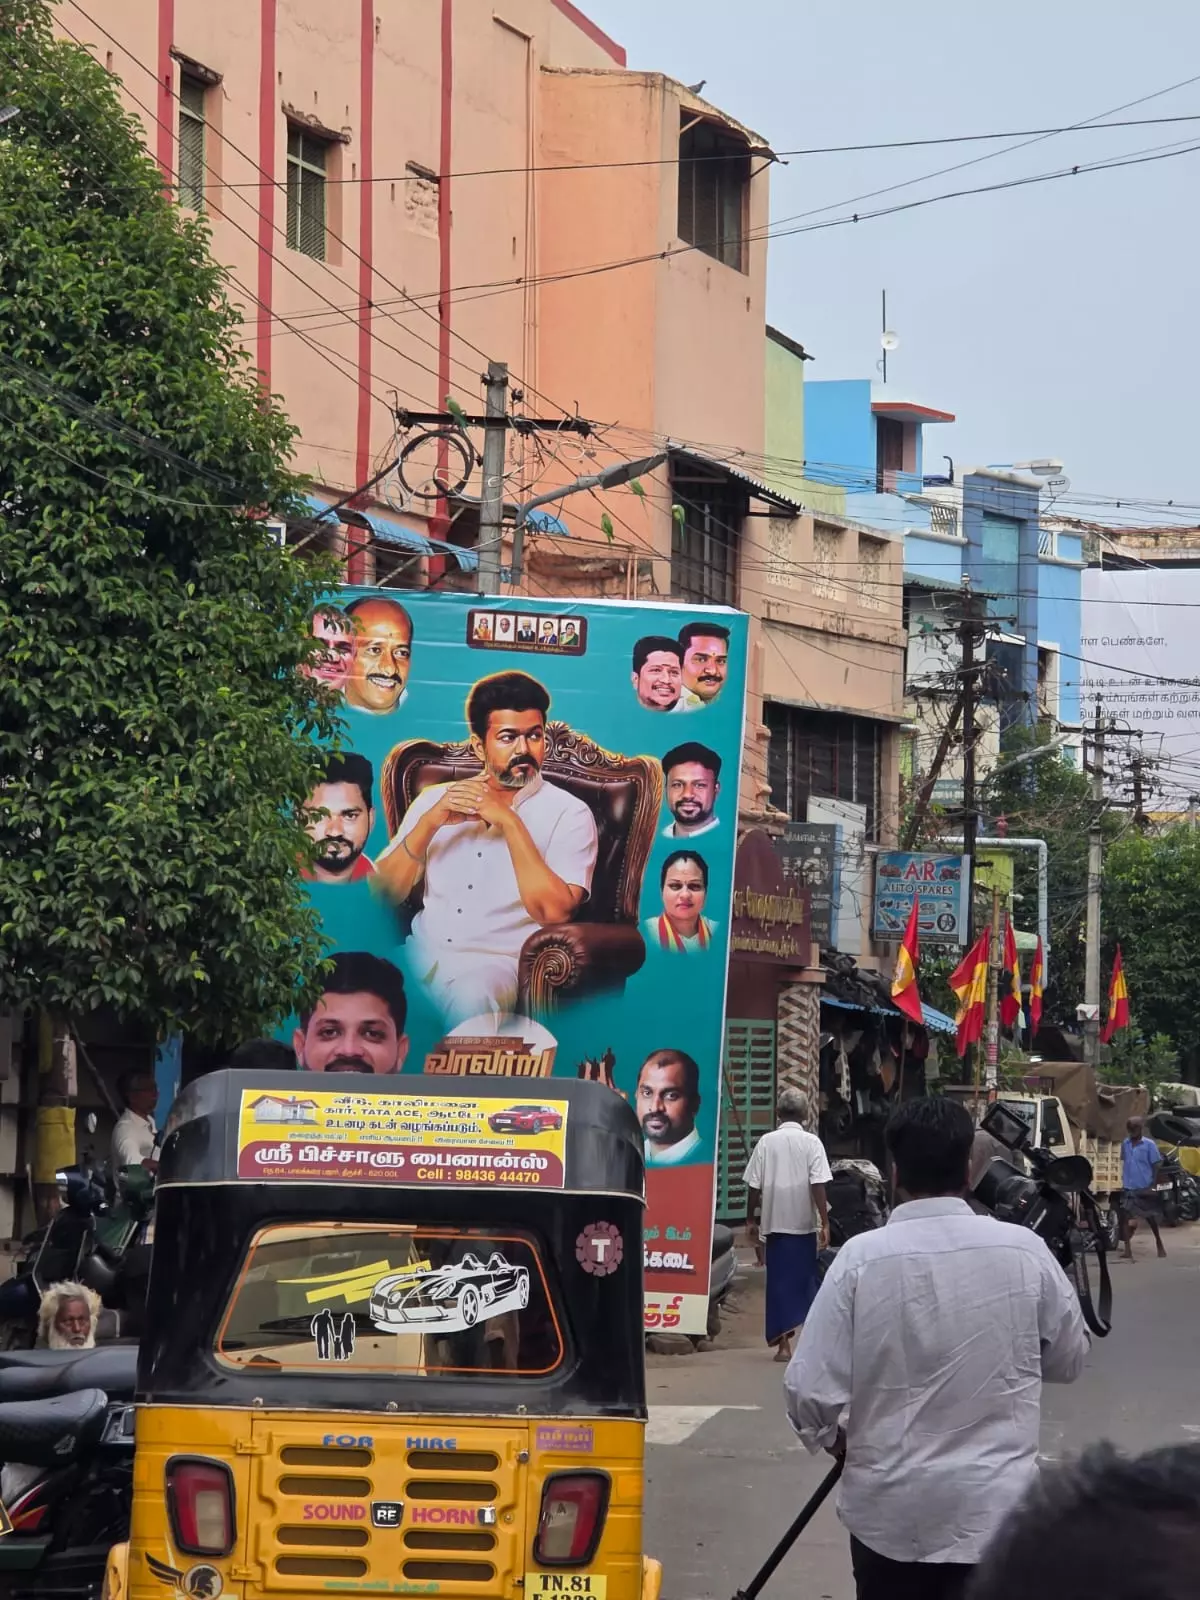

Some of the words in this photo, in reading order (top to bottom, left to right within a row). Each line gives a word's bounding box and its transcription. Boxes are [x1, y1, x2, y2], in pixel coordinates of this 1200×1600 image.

[904, 860, 937, 881] AR
[883, 883, 914, 893] AUTO
[917, 884, 953, 895] SPARES
[362, 1109, 391, 1117] TATA
[395, 1110, 422, 1118] ACE,
[326, 1120, 365, 1131] உடனடி
[369, 1119, 397, 1130] கடன்
[410, 1152, 548, 1170] பைனான்ஸ்
[417, 1168, 443, 1180] Cell
[456, 1169, 495, 1181] 98436
[500, 1171, 539, 1183] 44470
[592, 1239, 610, 1262] T
[323, 1434, 374, 1448] FOR
[405, 1436, 457, 1450] HIRE
[303, 1503, 366, 1520] SOUND
[412, 1507, 475, 1524] HORN
[377, 1509, 397, 1521] RE
[540, 1574, 591, 1592] TN.81
